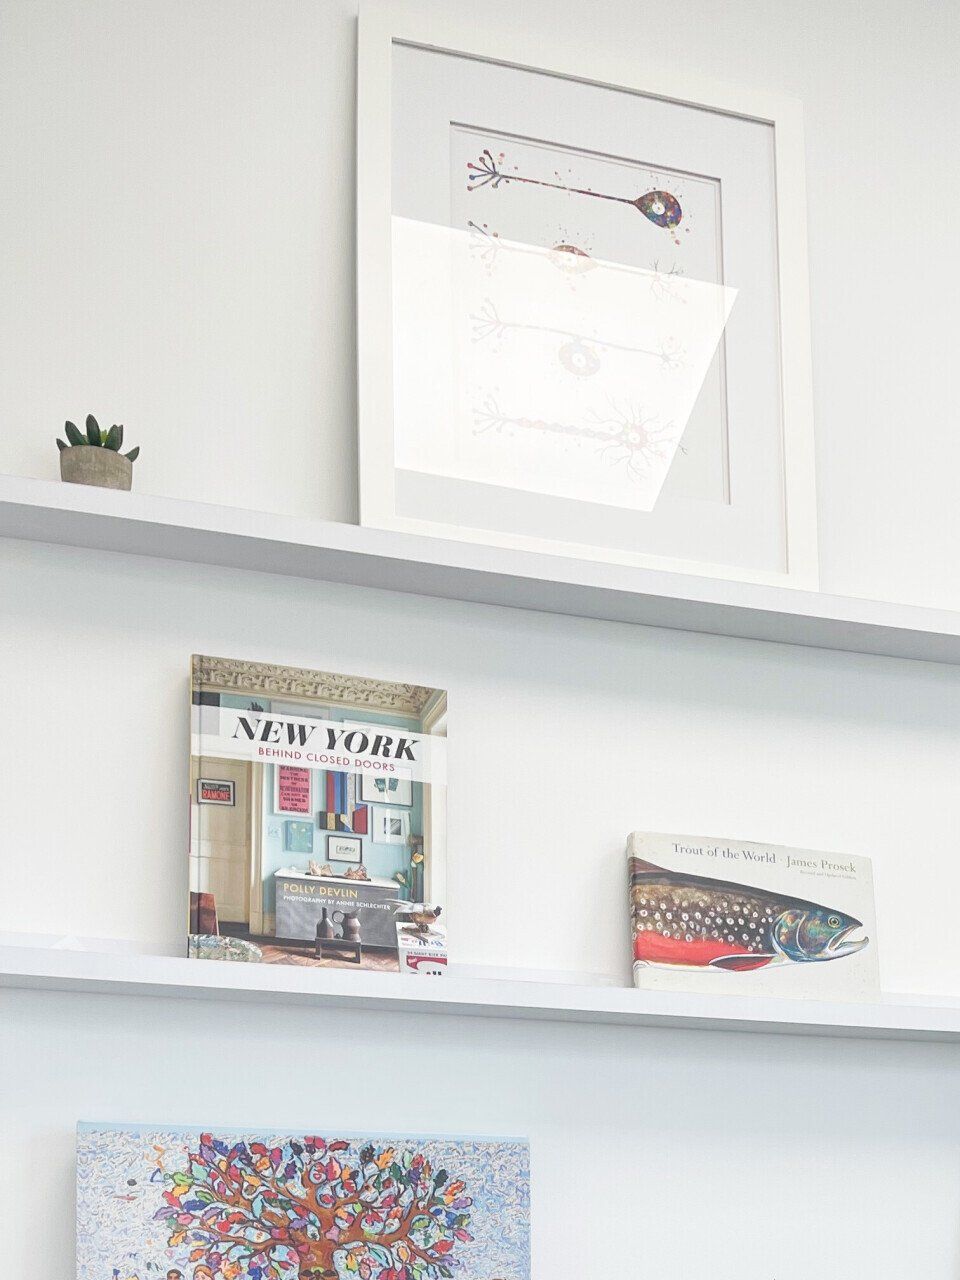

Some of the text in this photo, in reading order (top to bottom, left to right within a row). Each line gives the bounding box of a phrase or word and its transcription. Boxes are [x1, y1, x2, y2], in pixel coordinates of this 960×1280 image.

[231, 716, 420, 761] NEW YORK
[258, 746, 396, 772] BEHIND CLOSED DOORS
[672, 843, 857, 874] Trout of the World James Prosek
[283, 883, 358, 899] POLLY DEVLIN
[283, 895, 327, 905] PHOTOGRAPHY
